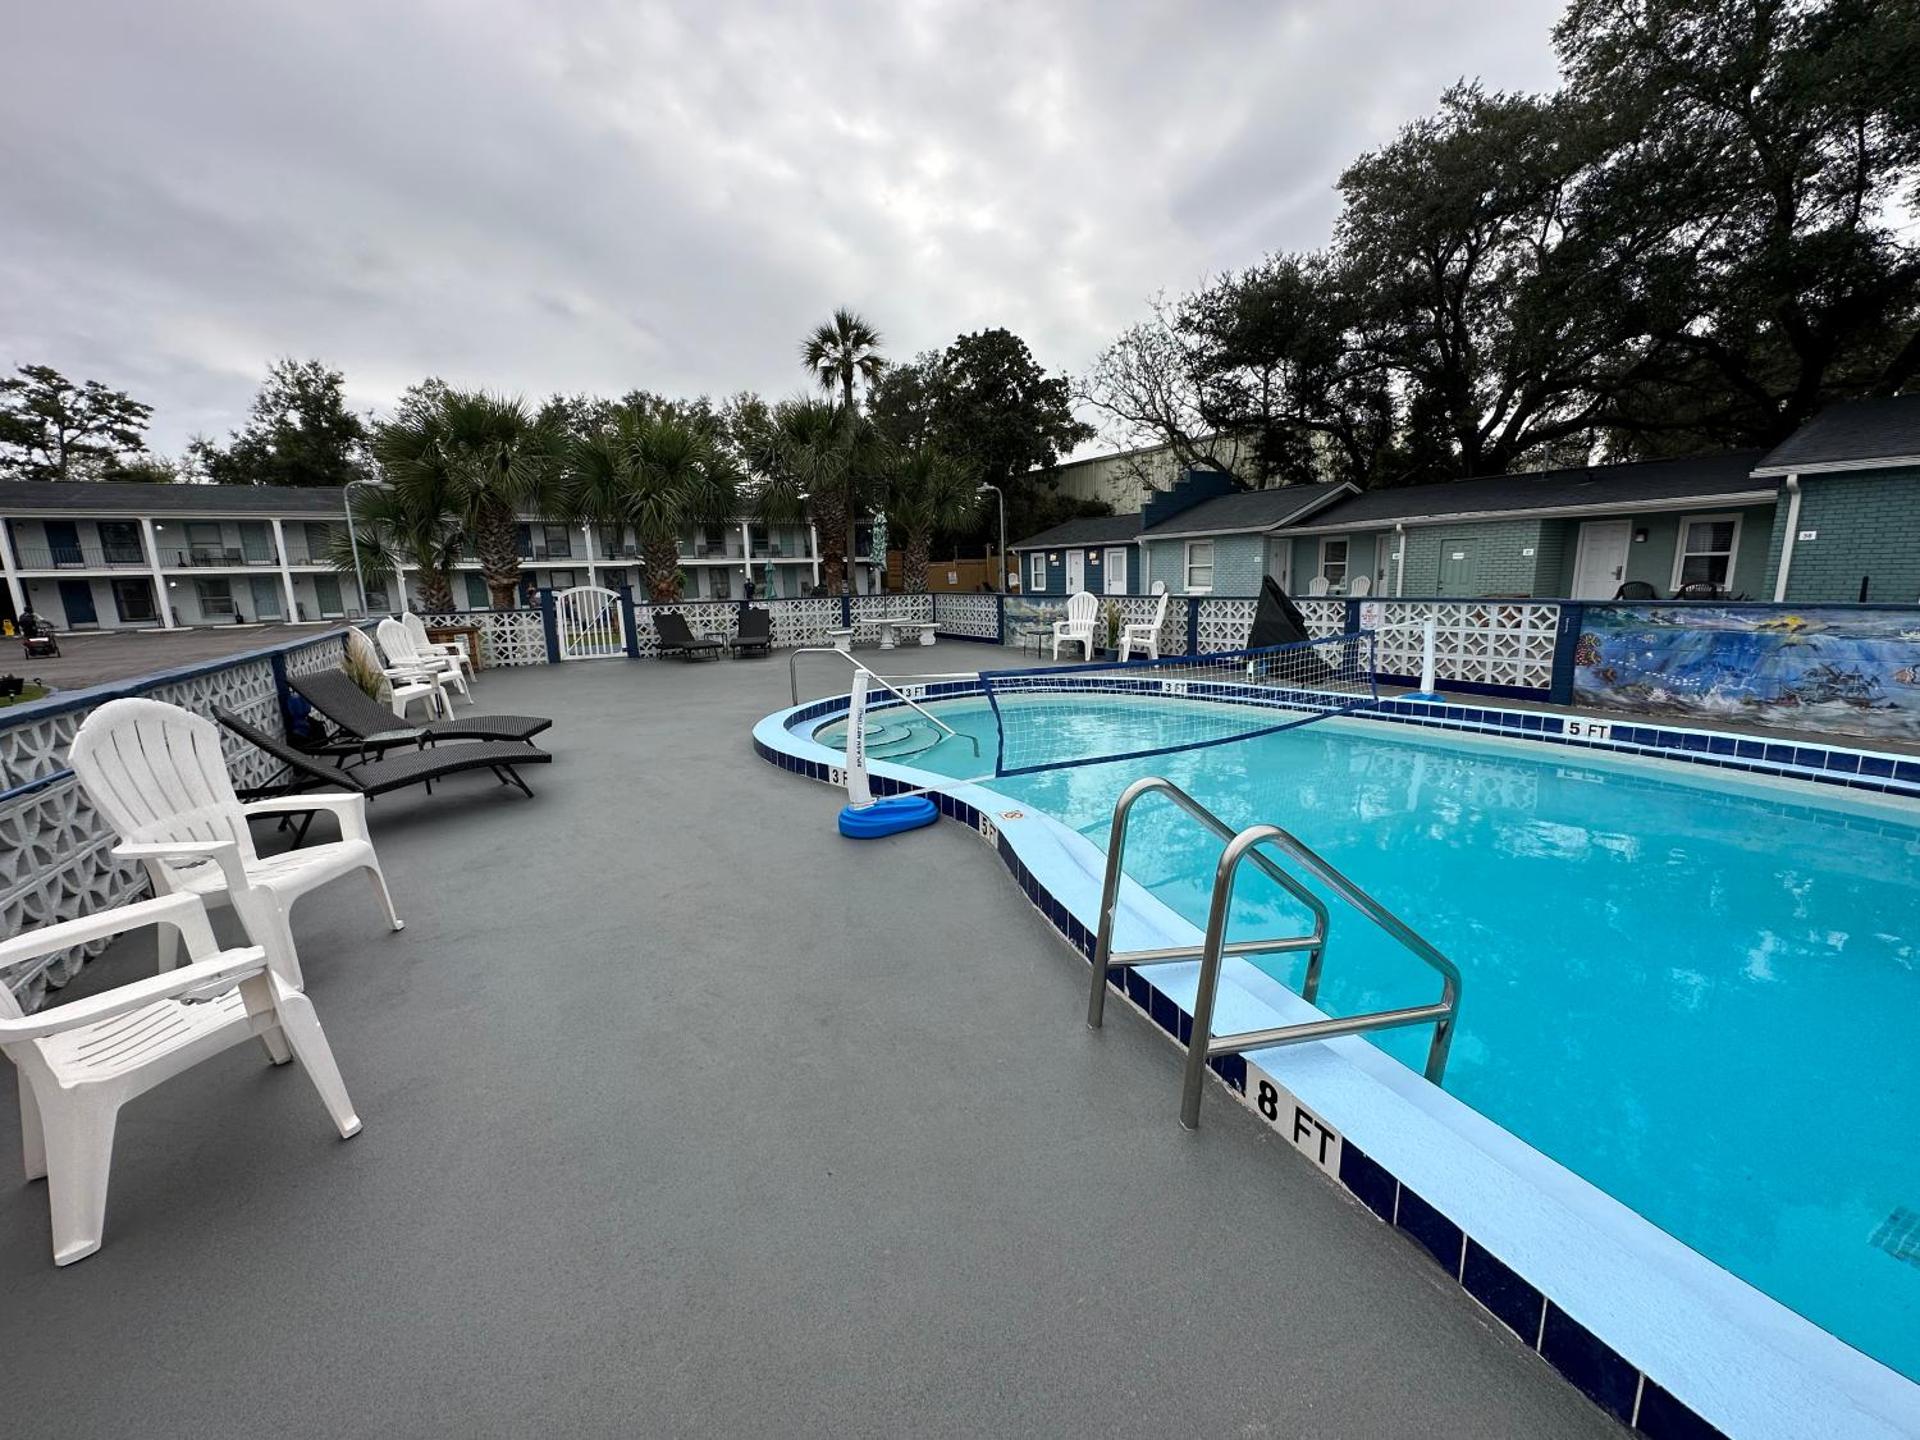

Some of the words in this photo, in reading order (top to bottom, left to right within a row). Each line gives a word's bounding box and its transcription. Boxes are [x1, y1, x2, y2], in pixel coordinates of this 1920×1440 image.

[905, 688, 912, 697] 3
[915, 687, 924, 697] FT
[1166, 683, 1171, 692] 3
[1569, 722, 1580, 735] 5
[1588, 724, 1608, 739] FT
[832, 768, 839, 783] 3
[982, 816, 988, 835] 5
[1257, 1079, 1279, 1122] 8
[1293, 1105, 1336, 1165] FT
